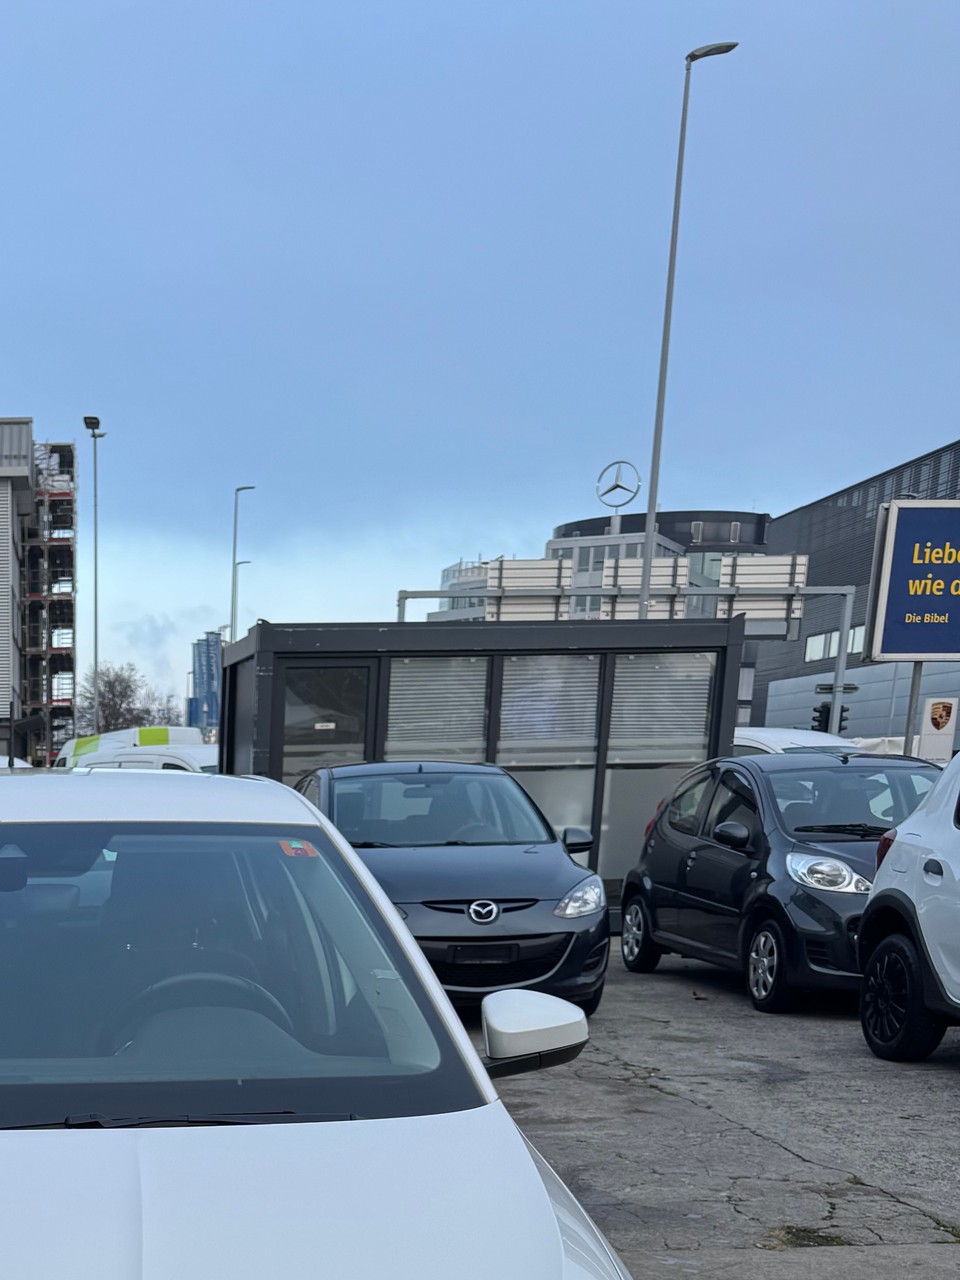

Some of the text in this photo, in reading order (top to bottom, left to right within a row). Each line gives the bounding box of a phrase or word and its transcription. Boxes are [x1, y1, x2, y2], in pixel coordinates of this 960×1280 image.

[908, 573, 945, 595] wie
[905, 613, 949, 623] Die Bibel
